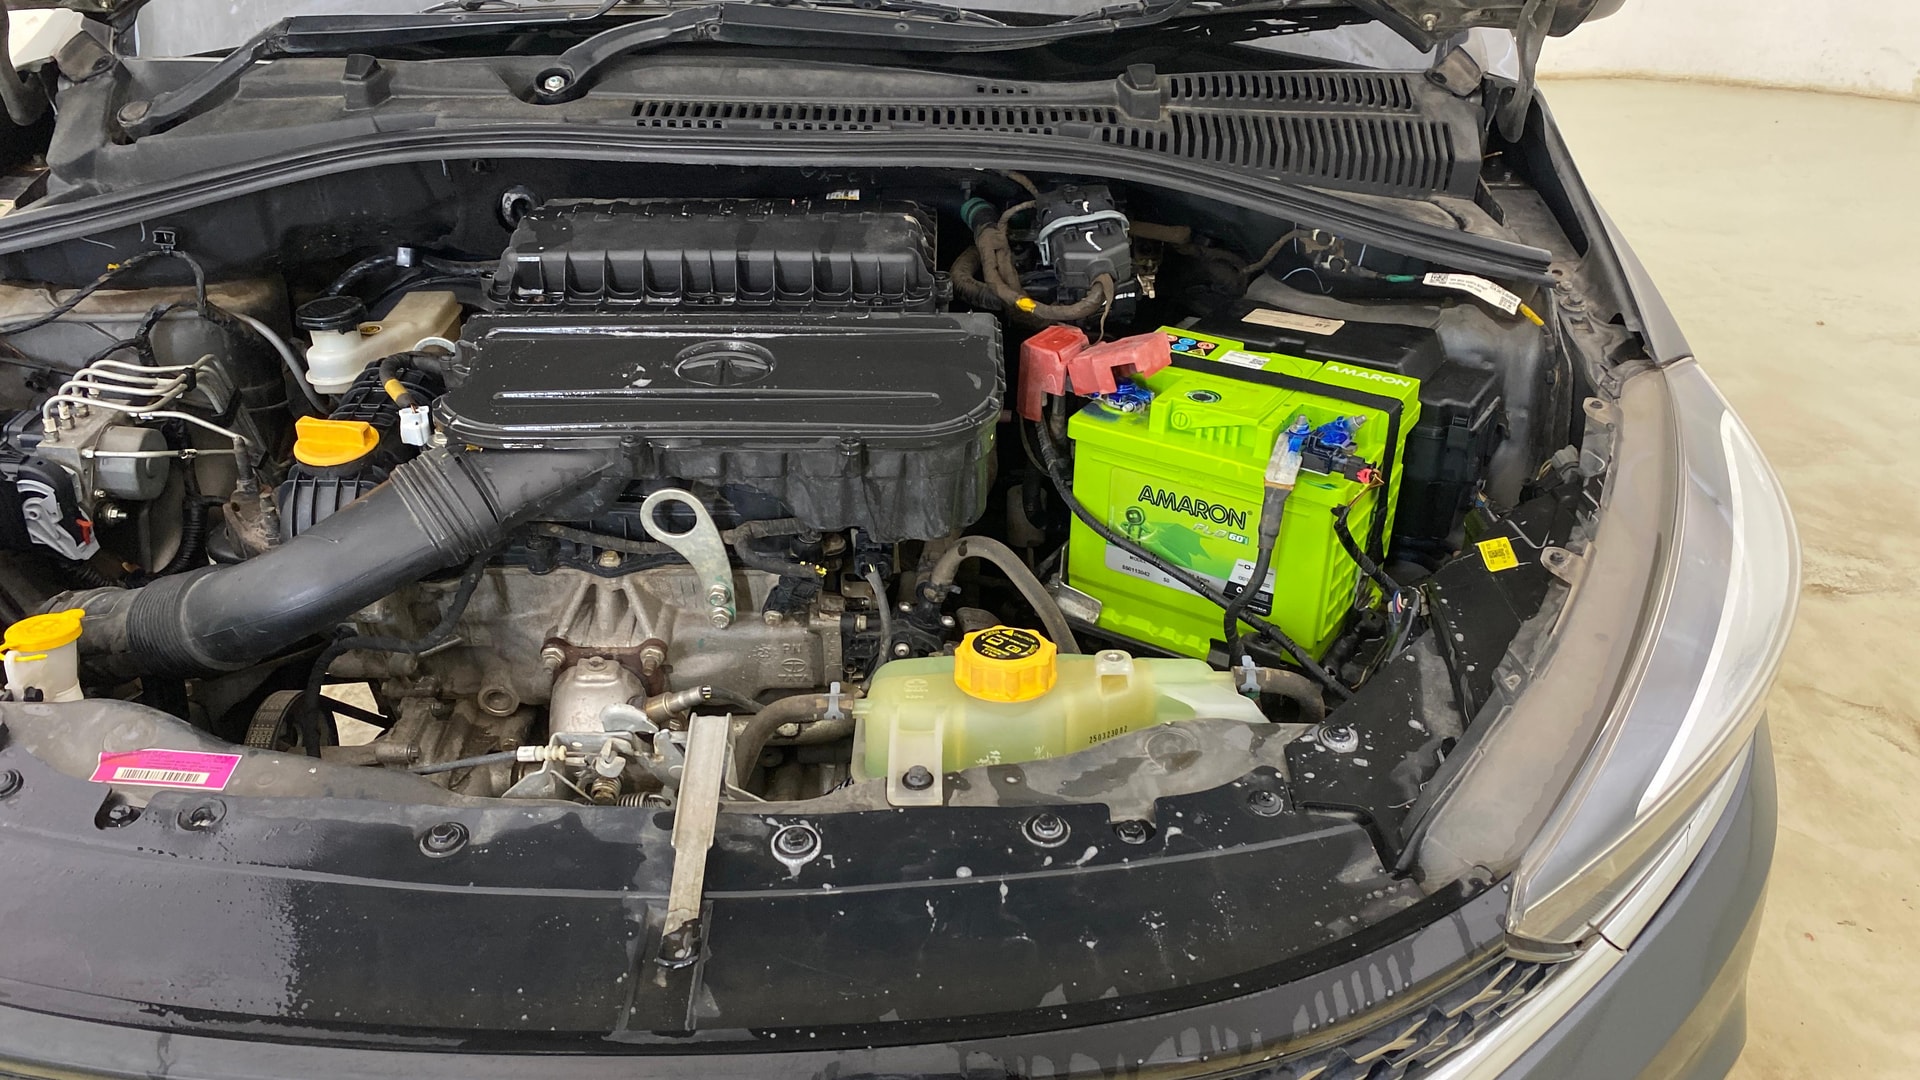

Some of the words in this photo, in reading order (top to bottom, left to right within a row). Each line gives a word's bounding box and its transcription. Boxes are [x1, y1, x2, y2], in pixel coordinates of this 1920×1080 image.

[1326, 365, 1411, 387] AMARON
[1138, 485, 1247, 530] AMARON
[1193, 523, 1228, 538] FLO
